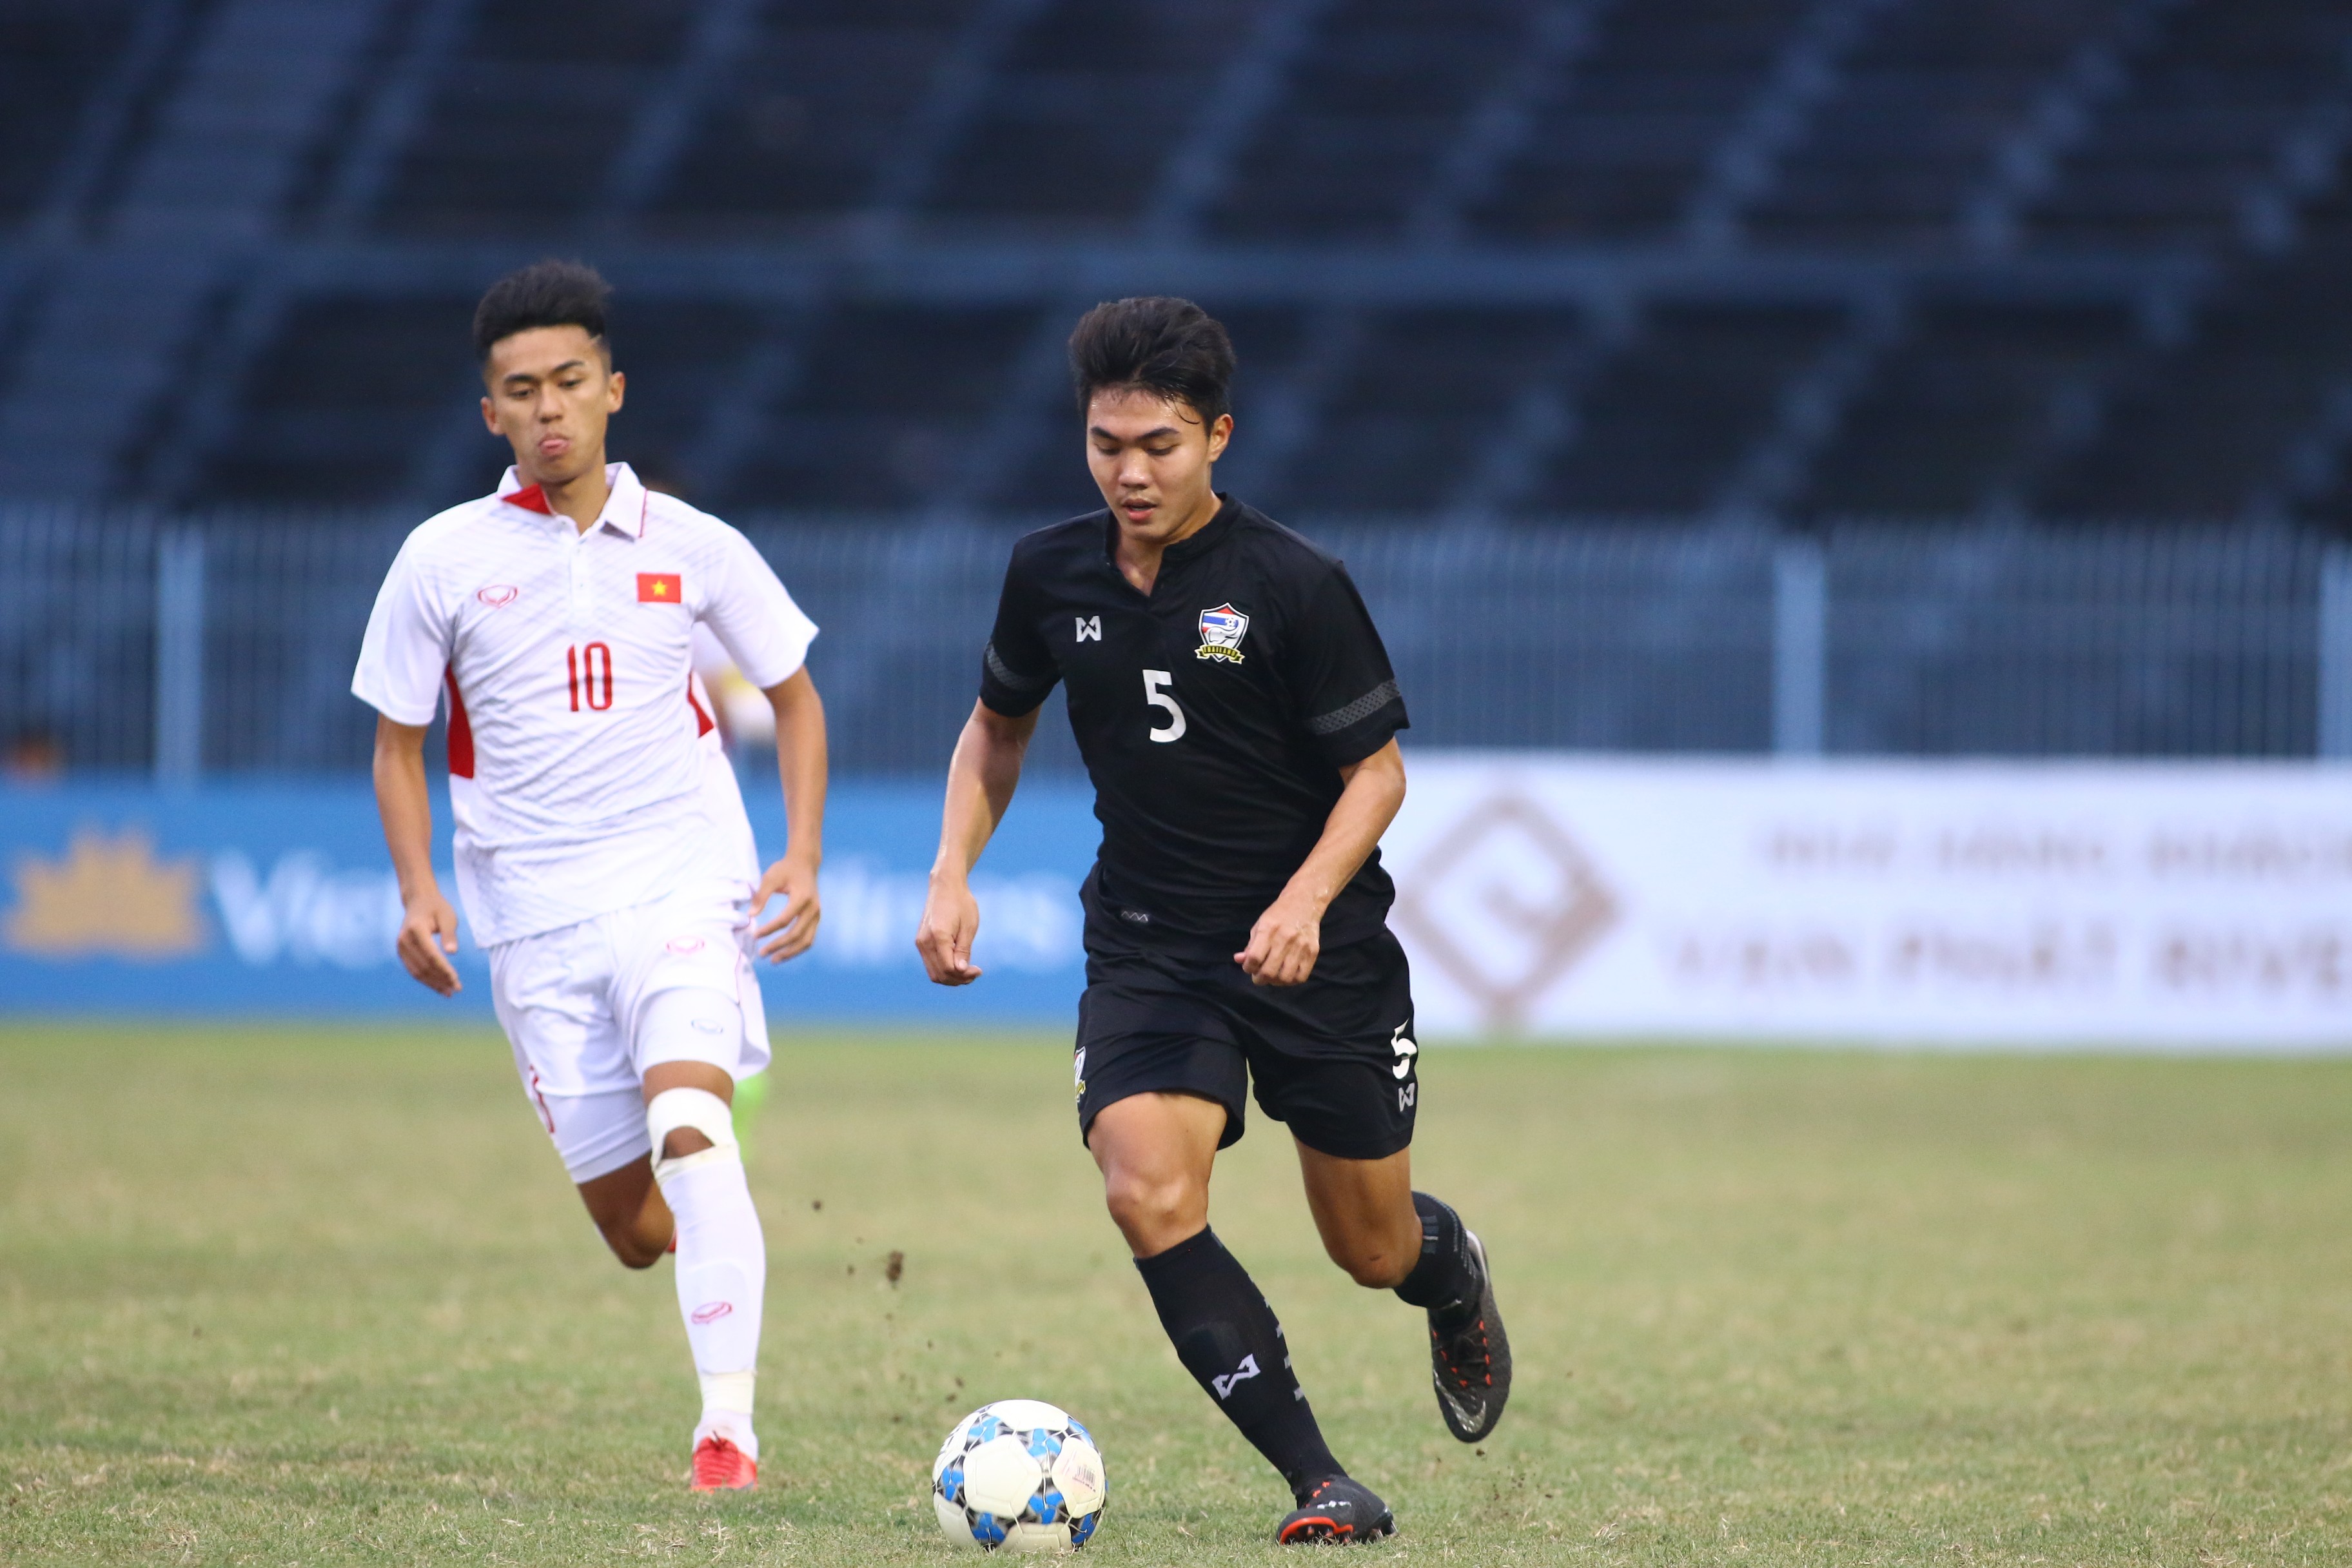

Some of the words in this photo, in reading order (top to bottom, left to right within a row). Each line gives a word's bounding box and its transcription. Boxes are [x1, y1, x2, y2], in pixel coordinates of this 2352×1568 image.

[567, 642, 613, 712] 10
[1202, 645, 1237, 657] THAILAND
[1142, 669, 1186, 742] 5
